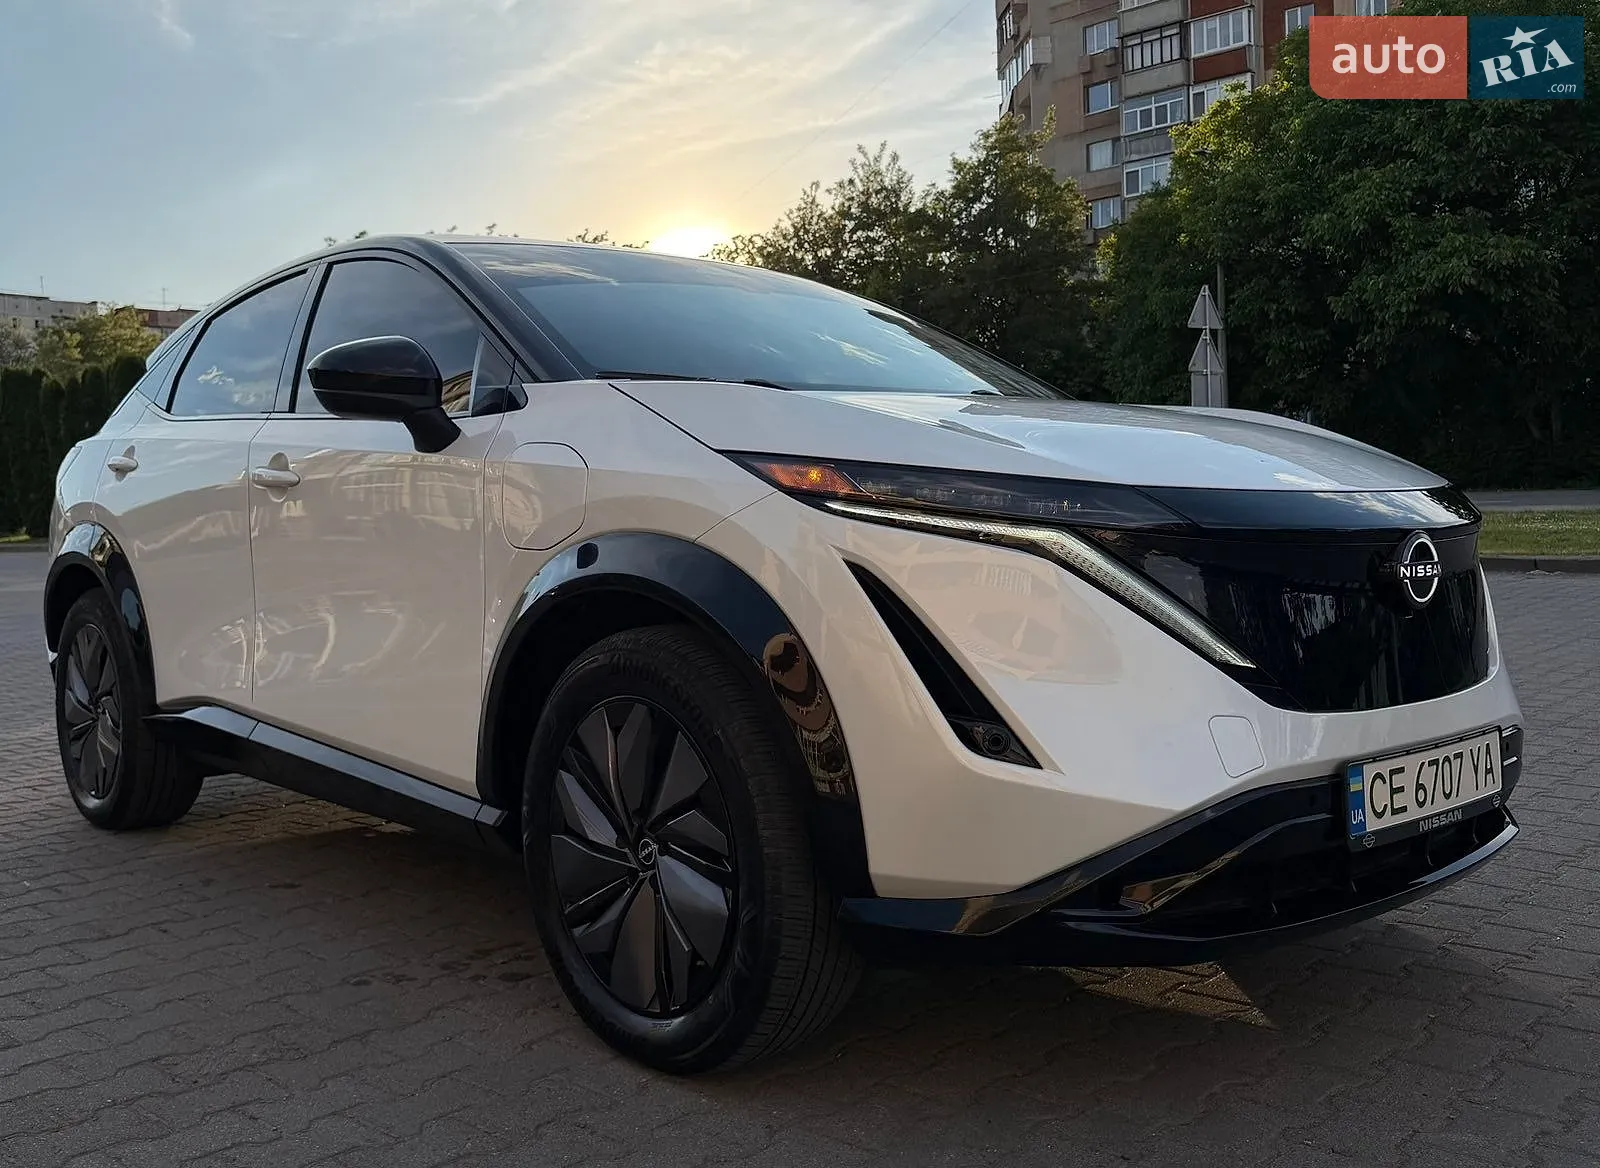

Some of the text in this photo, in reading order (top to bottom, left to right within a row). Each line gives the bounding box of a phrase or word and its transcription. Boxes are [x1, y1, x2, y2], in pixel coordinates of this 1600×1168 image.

[1369, 741, 1496, 819] CE 6707 YA
[1351, 809, 1365, 825] UA
[1418, 808, 1463, 832] NISSAN
